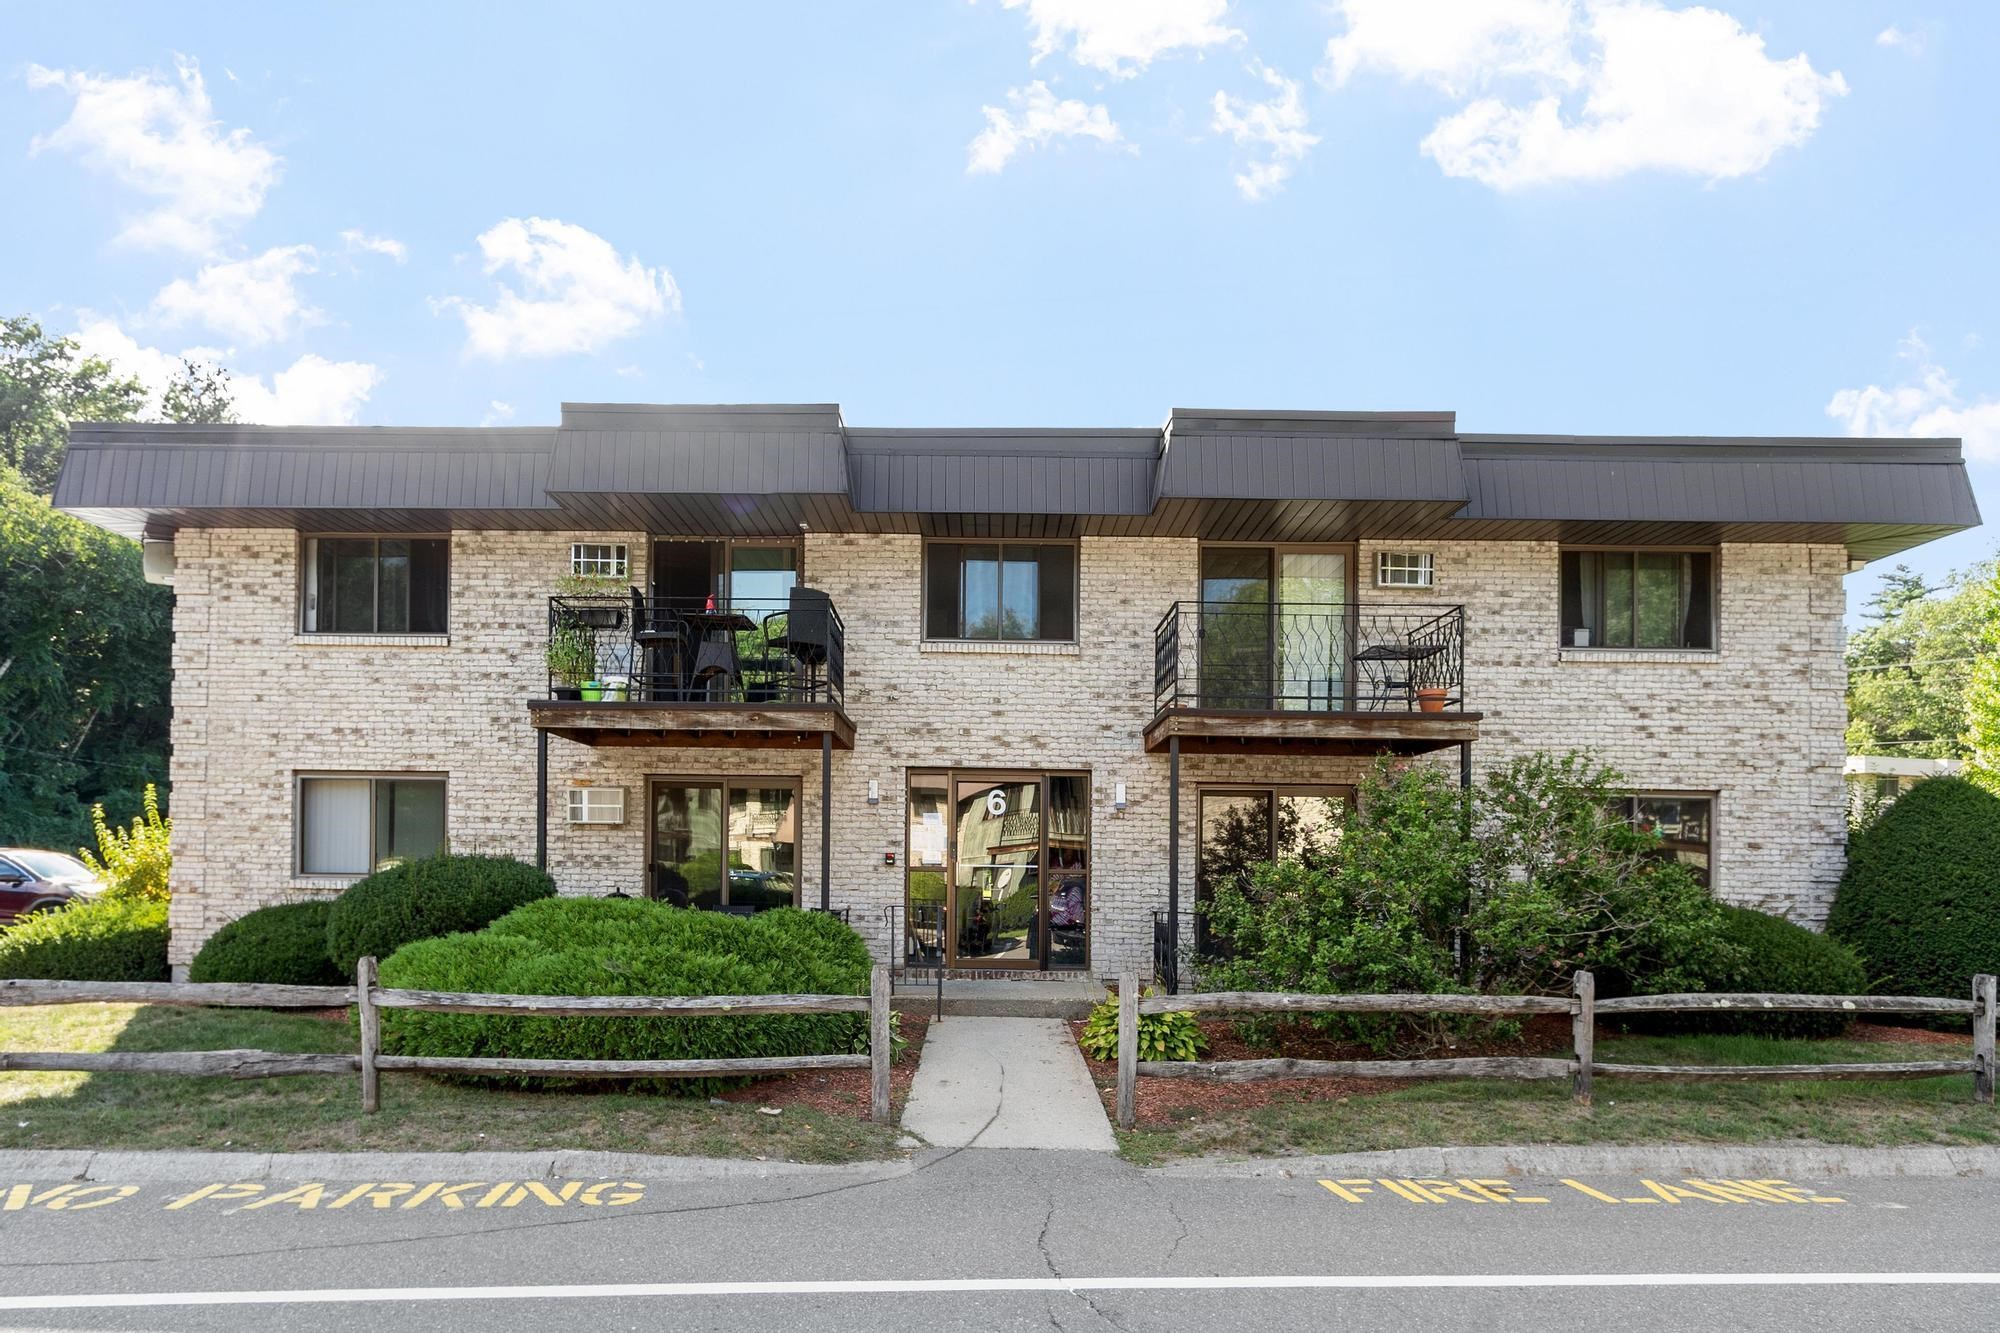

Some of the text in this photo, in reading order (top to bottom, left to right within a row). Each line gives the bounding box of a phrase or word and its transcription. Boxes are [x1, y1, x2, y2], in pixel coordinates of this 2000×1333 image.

[987, 789, 1006, 815] 6
[163, 1181, 647, 1210] PARKING
[1317, 1178, 1849, 1204] FIRE LANE
